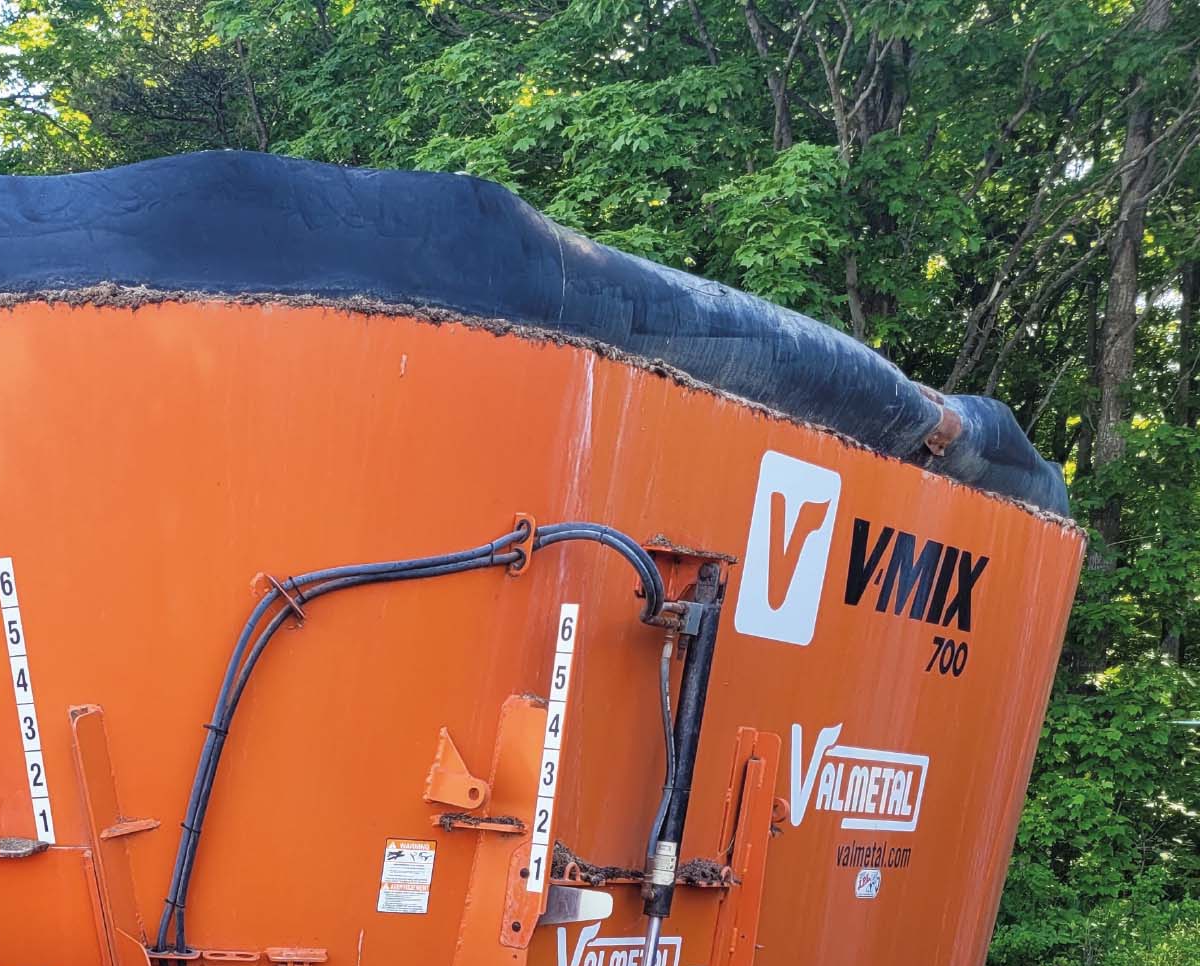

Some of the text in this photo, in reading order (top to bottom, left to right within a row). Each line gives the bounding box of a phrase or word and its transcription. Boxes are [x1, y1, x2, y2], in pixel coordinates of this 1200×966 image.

[0, 571, 13, 596] 6
[7, 619, 21, 645] 5
[561, 615, 574, 642] 6
[925, 636, 968, 677] 700
[16, 668, 28, 692] 4
[554, 664, 566, 690] 5
[24, 716, 36, 741] 3
[548, 713, 560, 739] 4
[30, 763, 44, 787] 2
[543, 761, 555, 786] 3
[789, 723, 914, 827] VALMETAL
[39, 809, 50, 833] 1
[536, 809, 548, 834] 2
[836, 840, 912, 869] valmetal.com
[533, 855, 542, 881] 1
